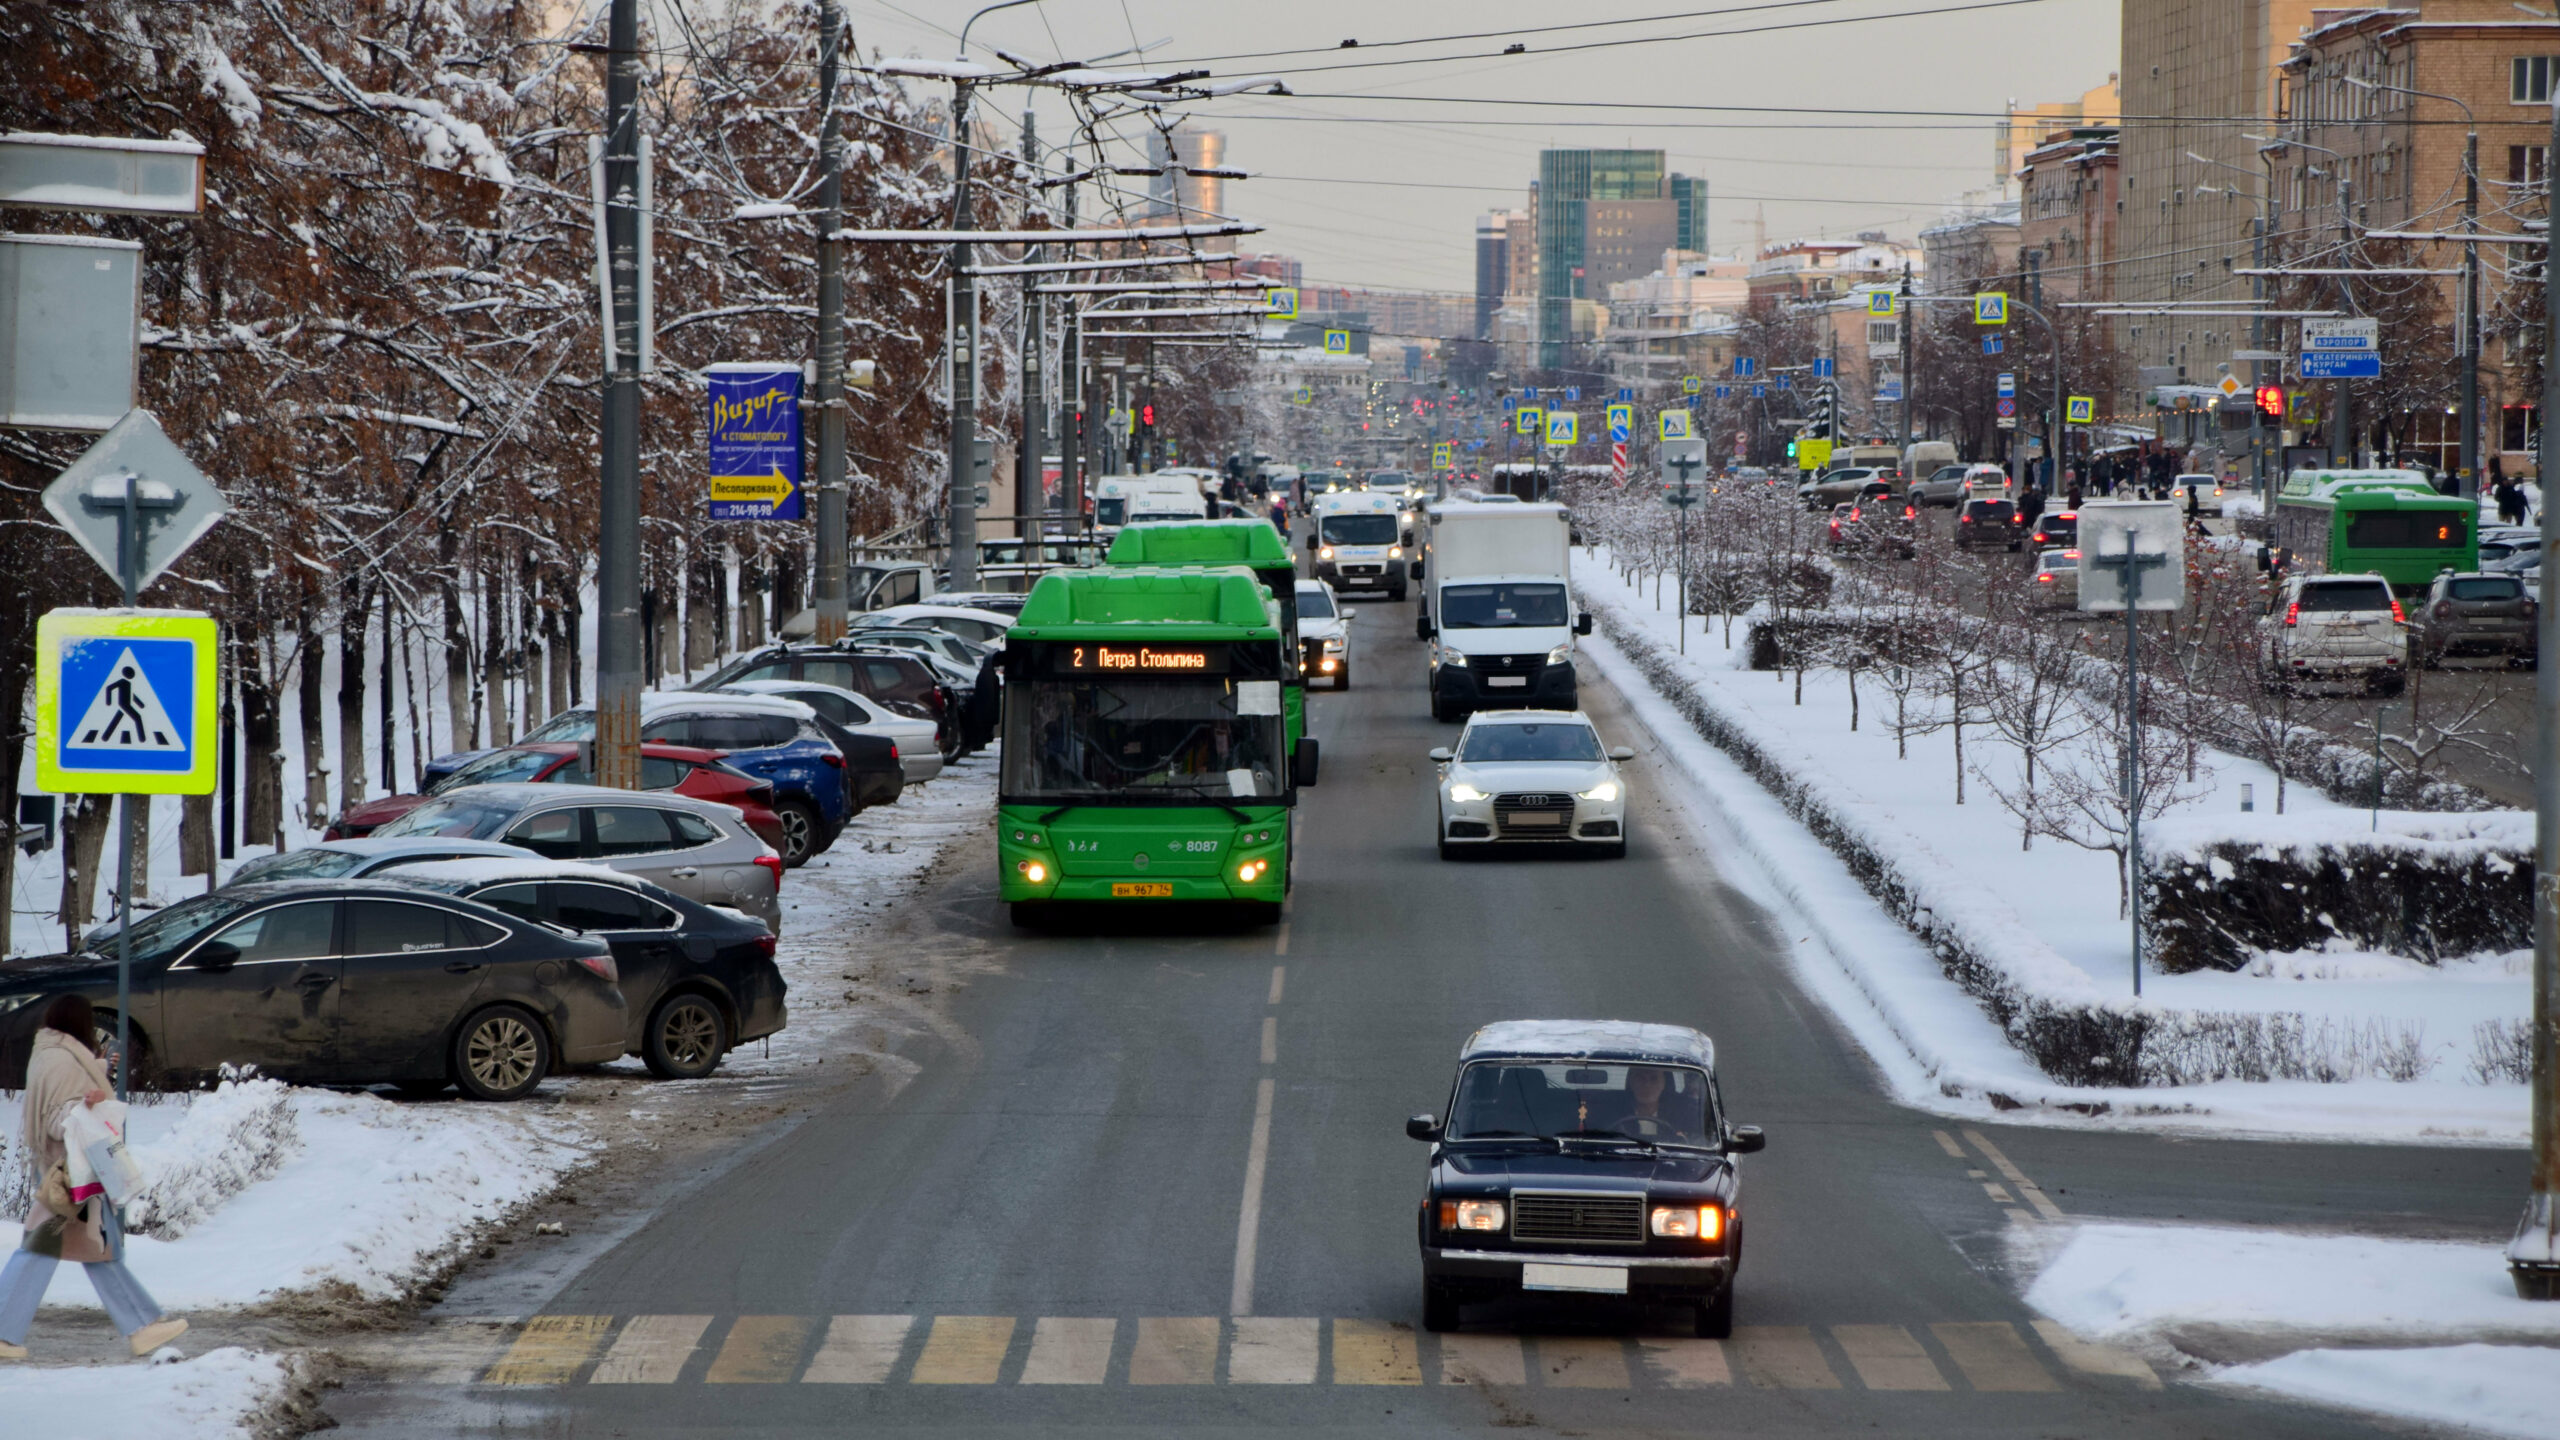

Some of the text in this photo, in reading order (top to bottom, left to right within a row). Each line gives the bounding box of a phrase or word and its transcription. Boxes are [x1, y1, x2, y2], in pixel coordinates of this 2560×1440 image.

[2316, 338, 2367, 346] АЭРОПОРТ
[2312, 353, 2379, 361] ЕКАТЕРИНБУРГ
[729, 432, 788, 442] СТОМАТОЛОГУ
[714, 482, 788, 496] Лесопарковая, 6
[729, 504, 773, 517] 214-98-98
[2438, 526, 2448, 540] 2
[1073, 648, 1205, 669] 2 Петра Столыпина
[1186, 840, 1218, 852] 8087
[1134, 885, 1152, 895] 967
